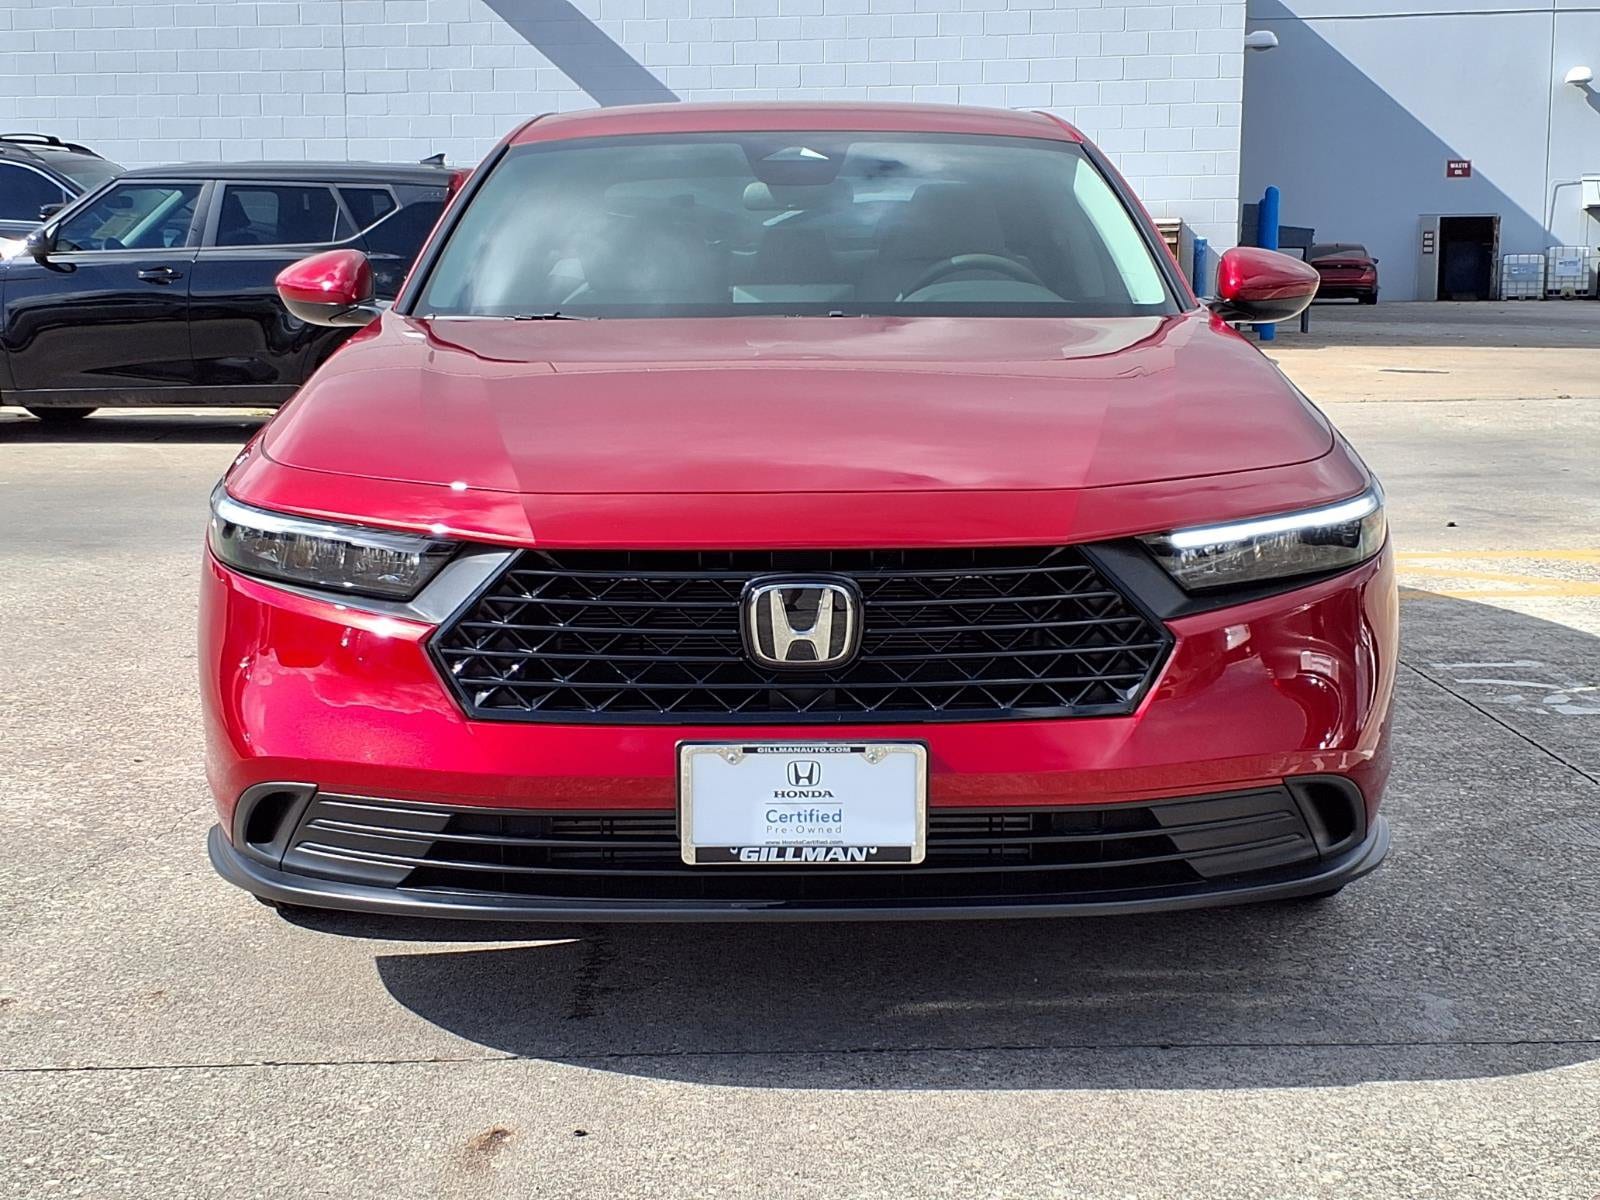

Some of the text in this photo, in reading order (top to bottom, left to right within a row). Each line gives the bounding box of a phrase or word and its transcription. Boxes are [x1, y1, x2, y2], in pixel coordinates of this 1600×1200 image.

[773, 790, 834, 798] HONDA
[765, 808, 842, 823] Certified
[766, 825, 842, 834] Pre-Owned
[740, 847, 868, 862] GILLMAN
